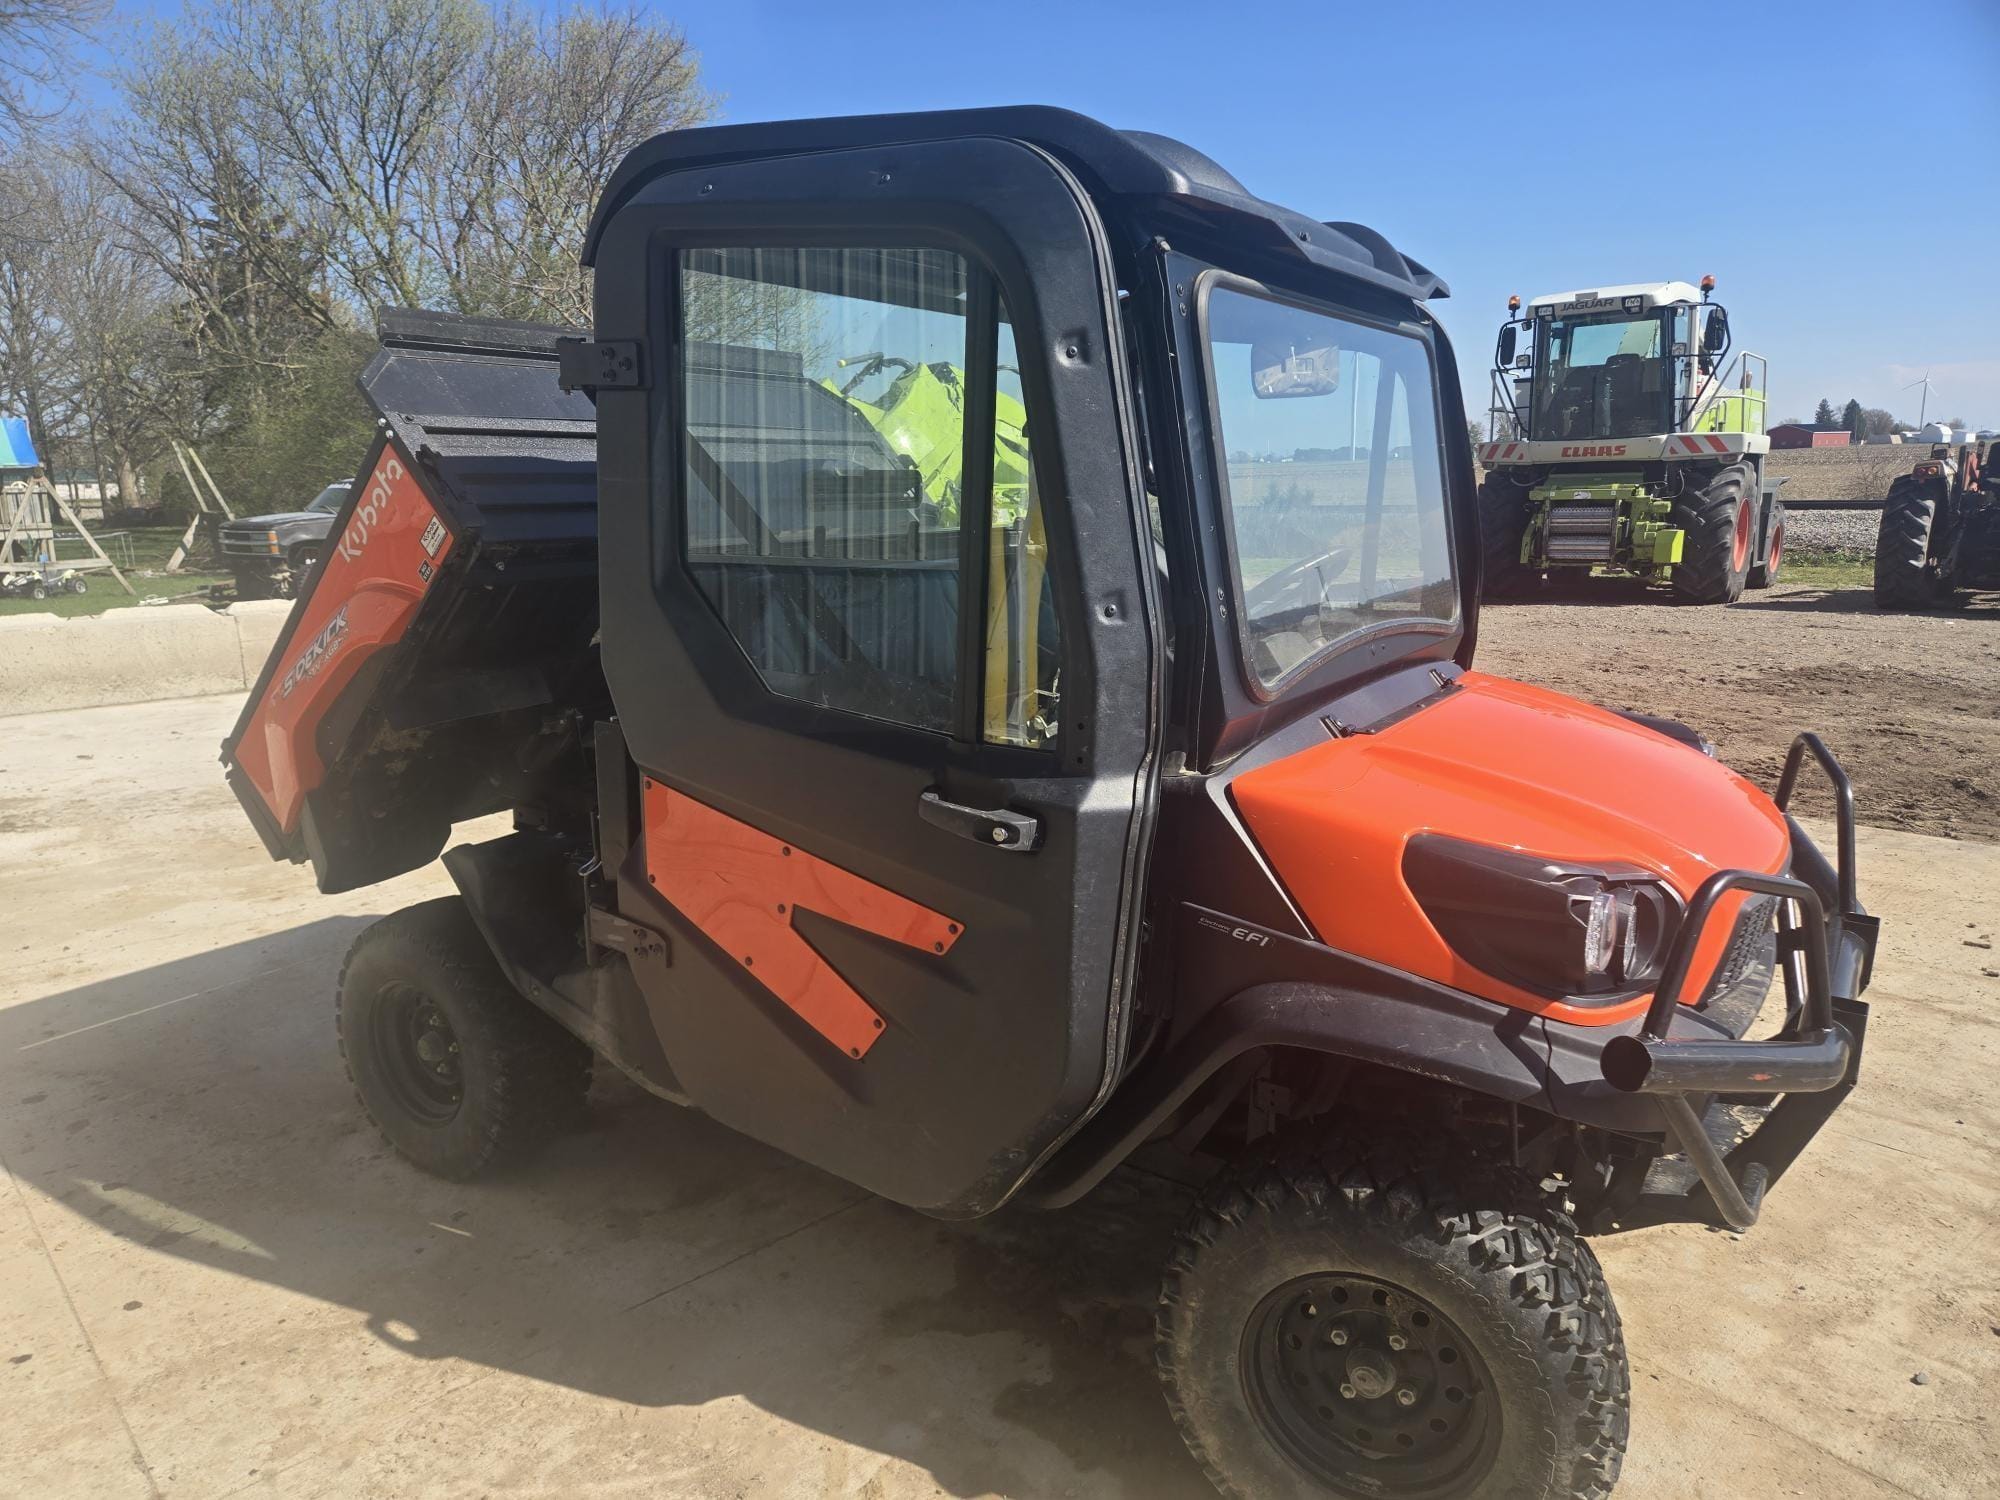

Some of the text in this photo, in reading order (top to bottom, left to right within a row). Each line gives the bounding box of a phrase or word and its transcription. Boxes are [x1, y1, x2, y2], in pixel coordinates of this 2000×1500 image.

[1560, 298, 1614, 312] JAGUAR
[1561, 445, 1627, 457] CLAAS
[338, 459, 403, 562] Kubota
[1232, 927, 1269, 946] EFI
